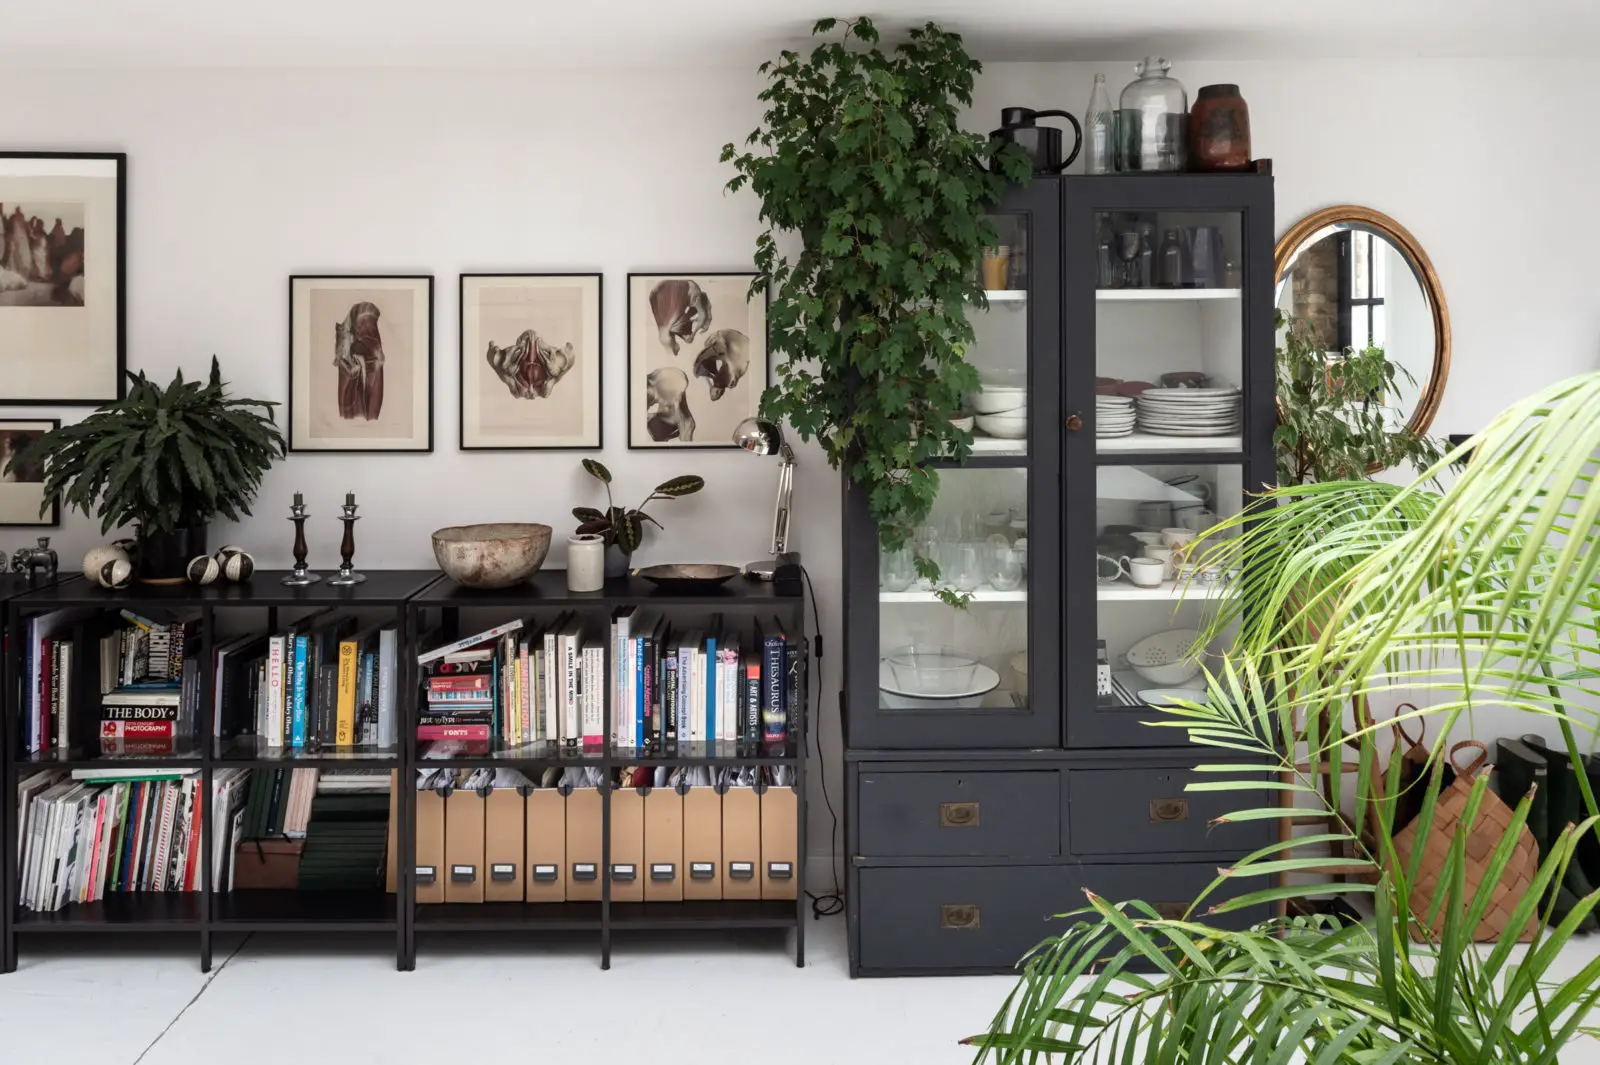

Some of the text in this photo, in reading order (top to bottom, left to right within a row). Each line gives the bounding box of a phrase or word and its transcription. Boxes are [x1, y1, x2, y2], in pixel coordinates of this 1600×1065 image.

[149, 632, 170, 678] CENTURY
[770, 649, 780, 713] THESAURUS
[107, 708, 169, 718] THE BODY
[749, 704, 757, 725] ARTISTS
